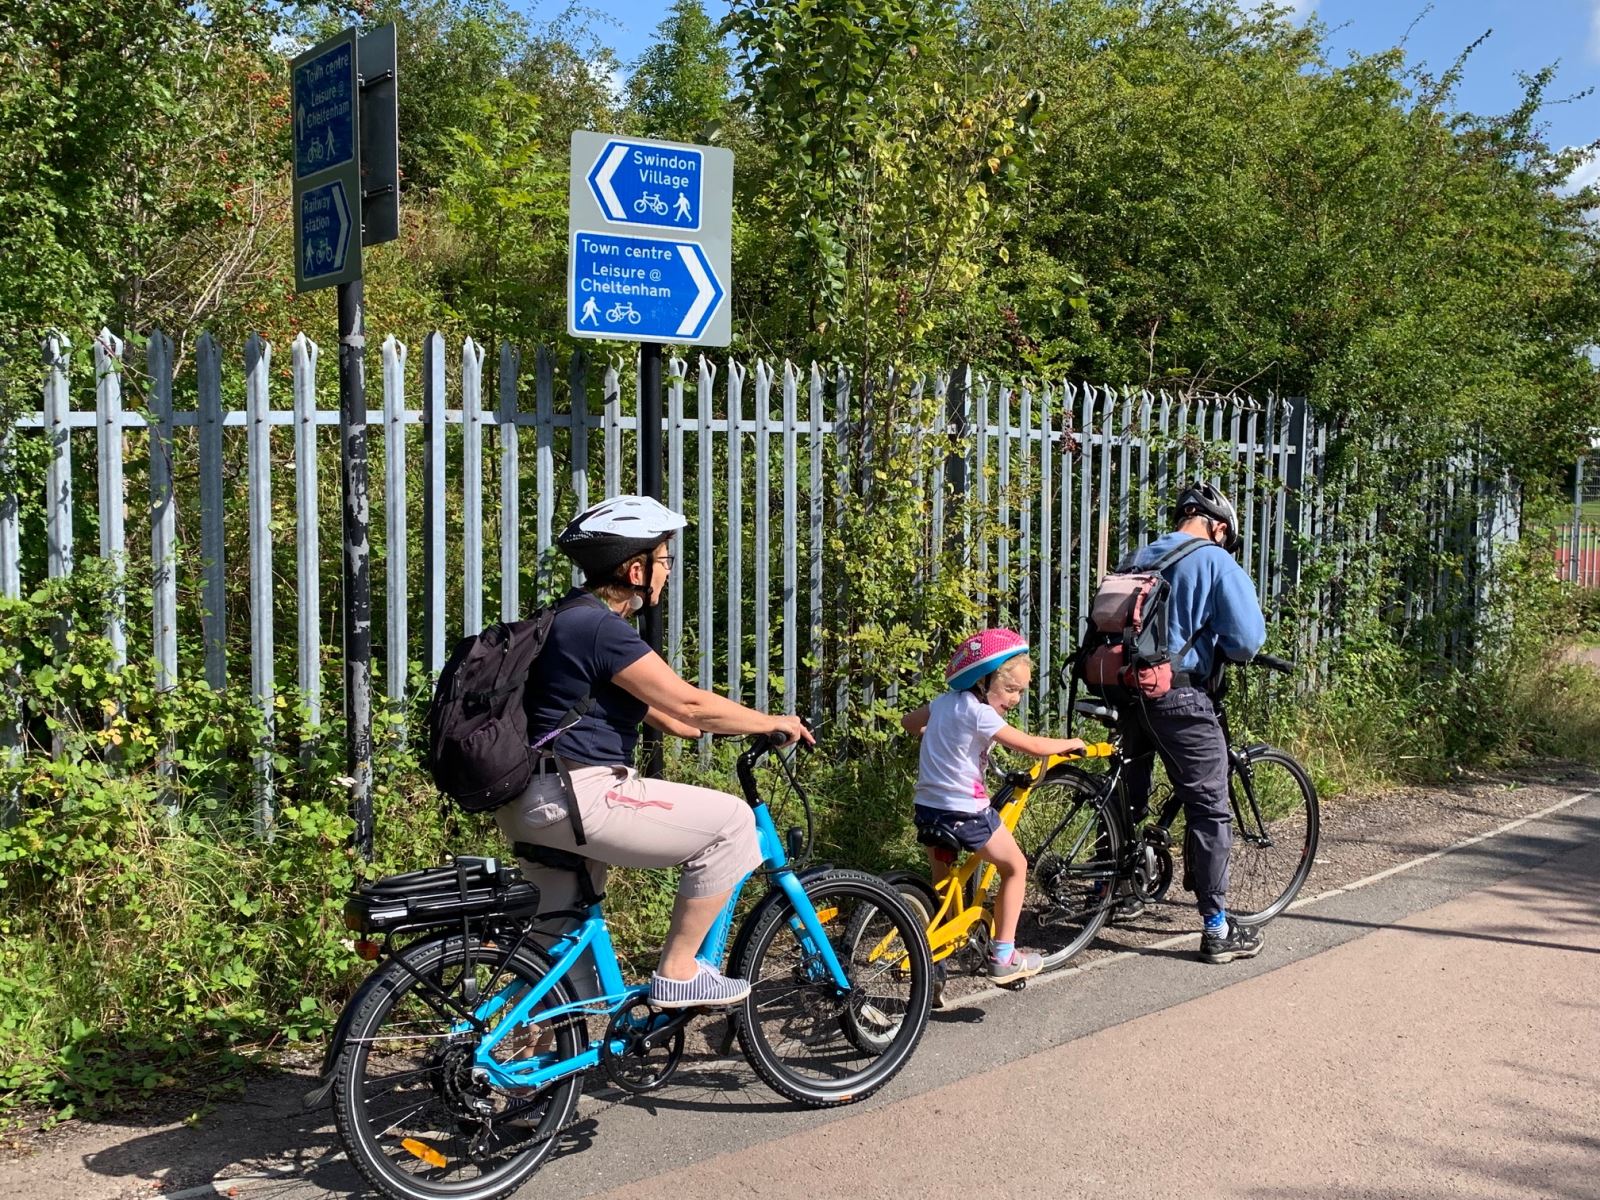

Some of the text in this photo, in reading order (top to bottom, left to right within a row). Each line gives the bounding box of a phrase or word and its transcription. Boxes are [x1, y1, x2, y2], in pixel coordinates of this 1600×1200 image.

[305, 54, 349, 83] Town centre
[311, 80, 345, 107] Leisure @
[306, 101, 350, 129] Cheltenham
[633, 150, 696, 171] Swindon
[639, 169, 690, 189] Village
[304, 196, 331, 214] Railway
[305, 215, 330, 233] station
[581, 239, 672, 261] Town centre
[592, 262, 662, 282] Leisure @
[581, 278, 671, 298] Cheltenham
